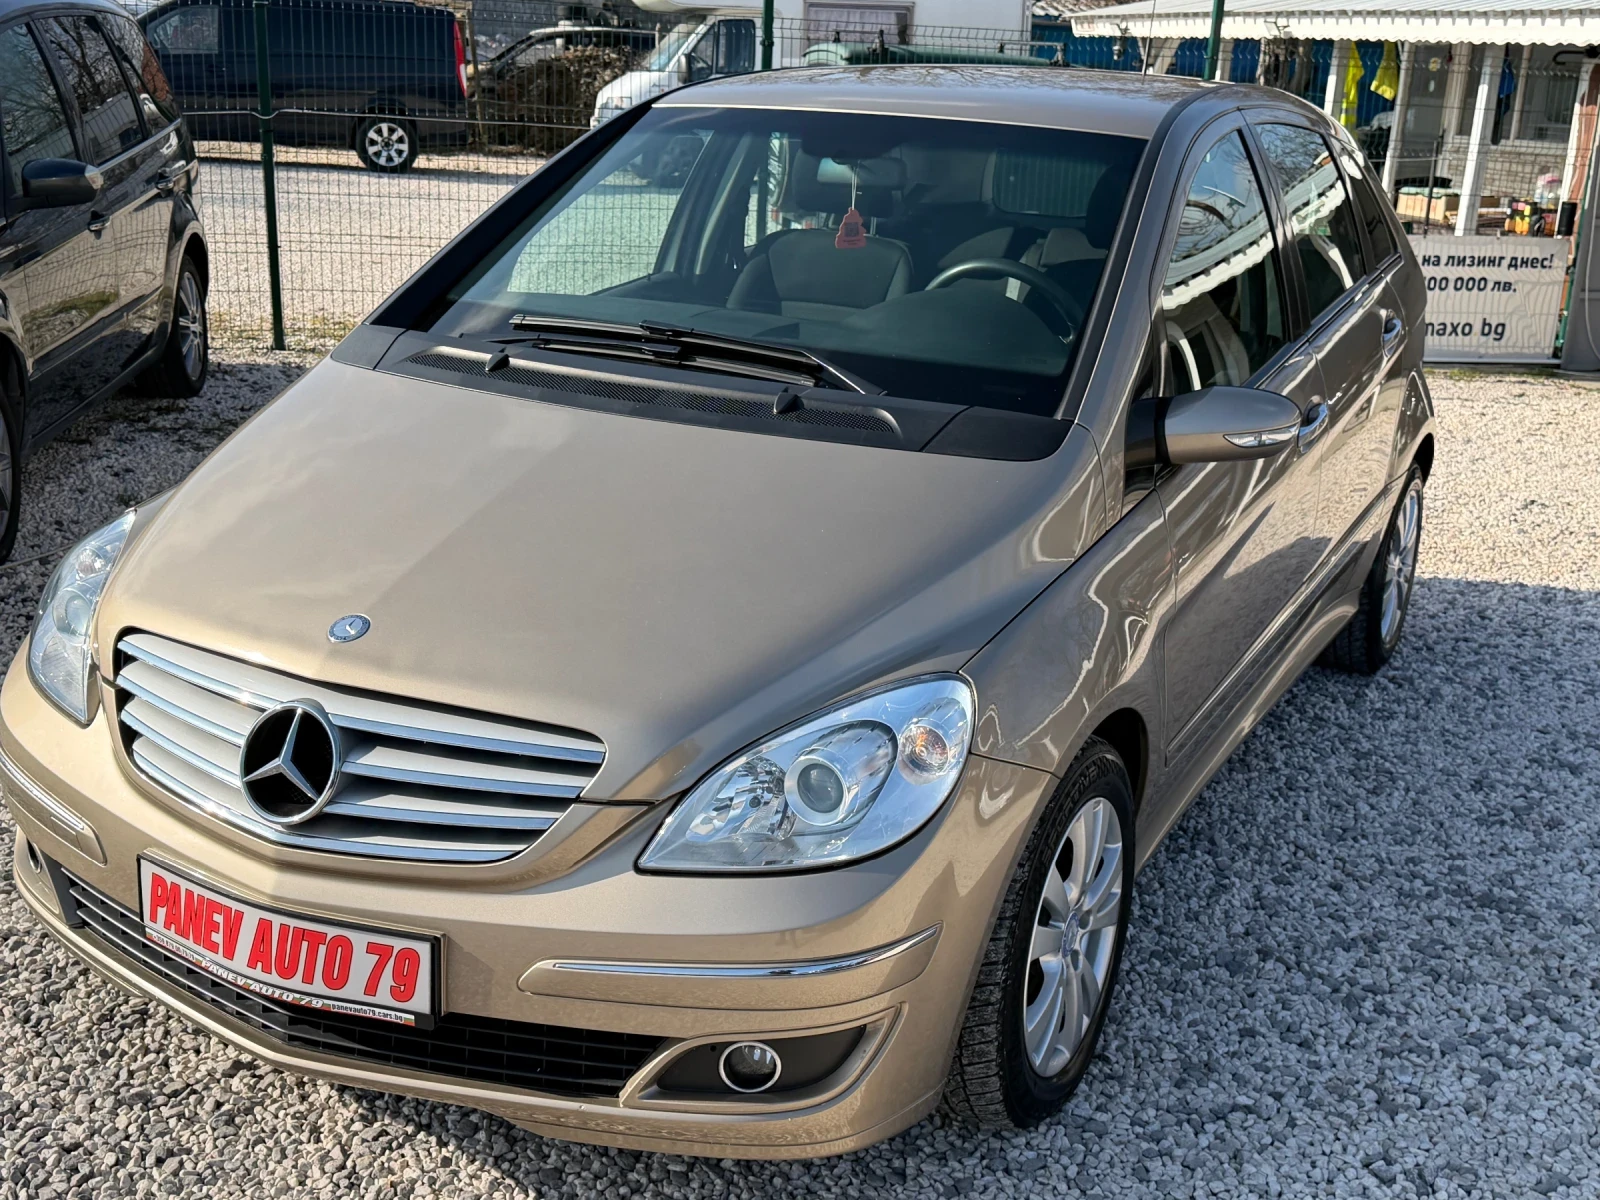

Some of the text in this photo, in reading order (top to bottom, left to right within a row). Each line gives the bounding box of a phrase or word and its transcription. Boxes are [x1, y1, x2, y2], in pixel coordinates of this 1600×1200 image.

[1421, 253, 1555, 271] на лизинг днес!
[1424, 276, 1517, 293] 00 000 лв.
[149, 872, 421, 1003] PANEV AUTO 79
[201, 958, 247, 986] PANEV
[249, 982, 295, 1002] AUTO
[298, 995, 324, 1008] 79
[331, 1002, 404, 1022] panevauto79.cars.bg
